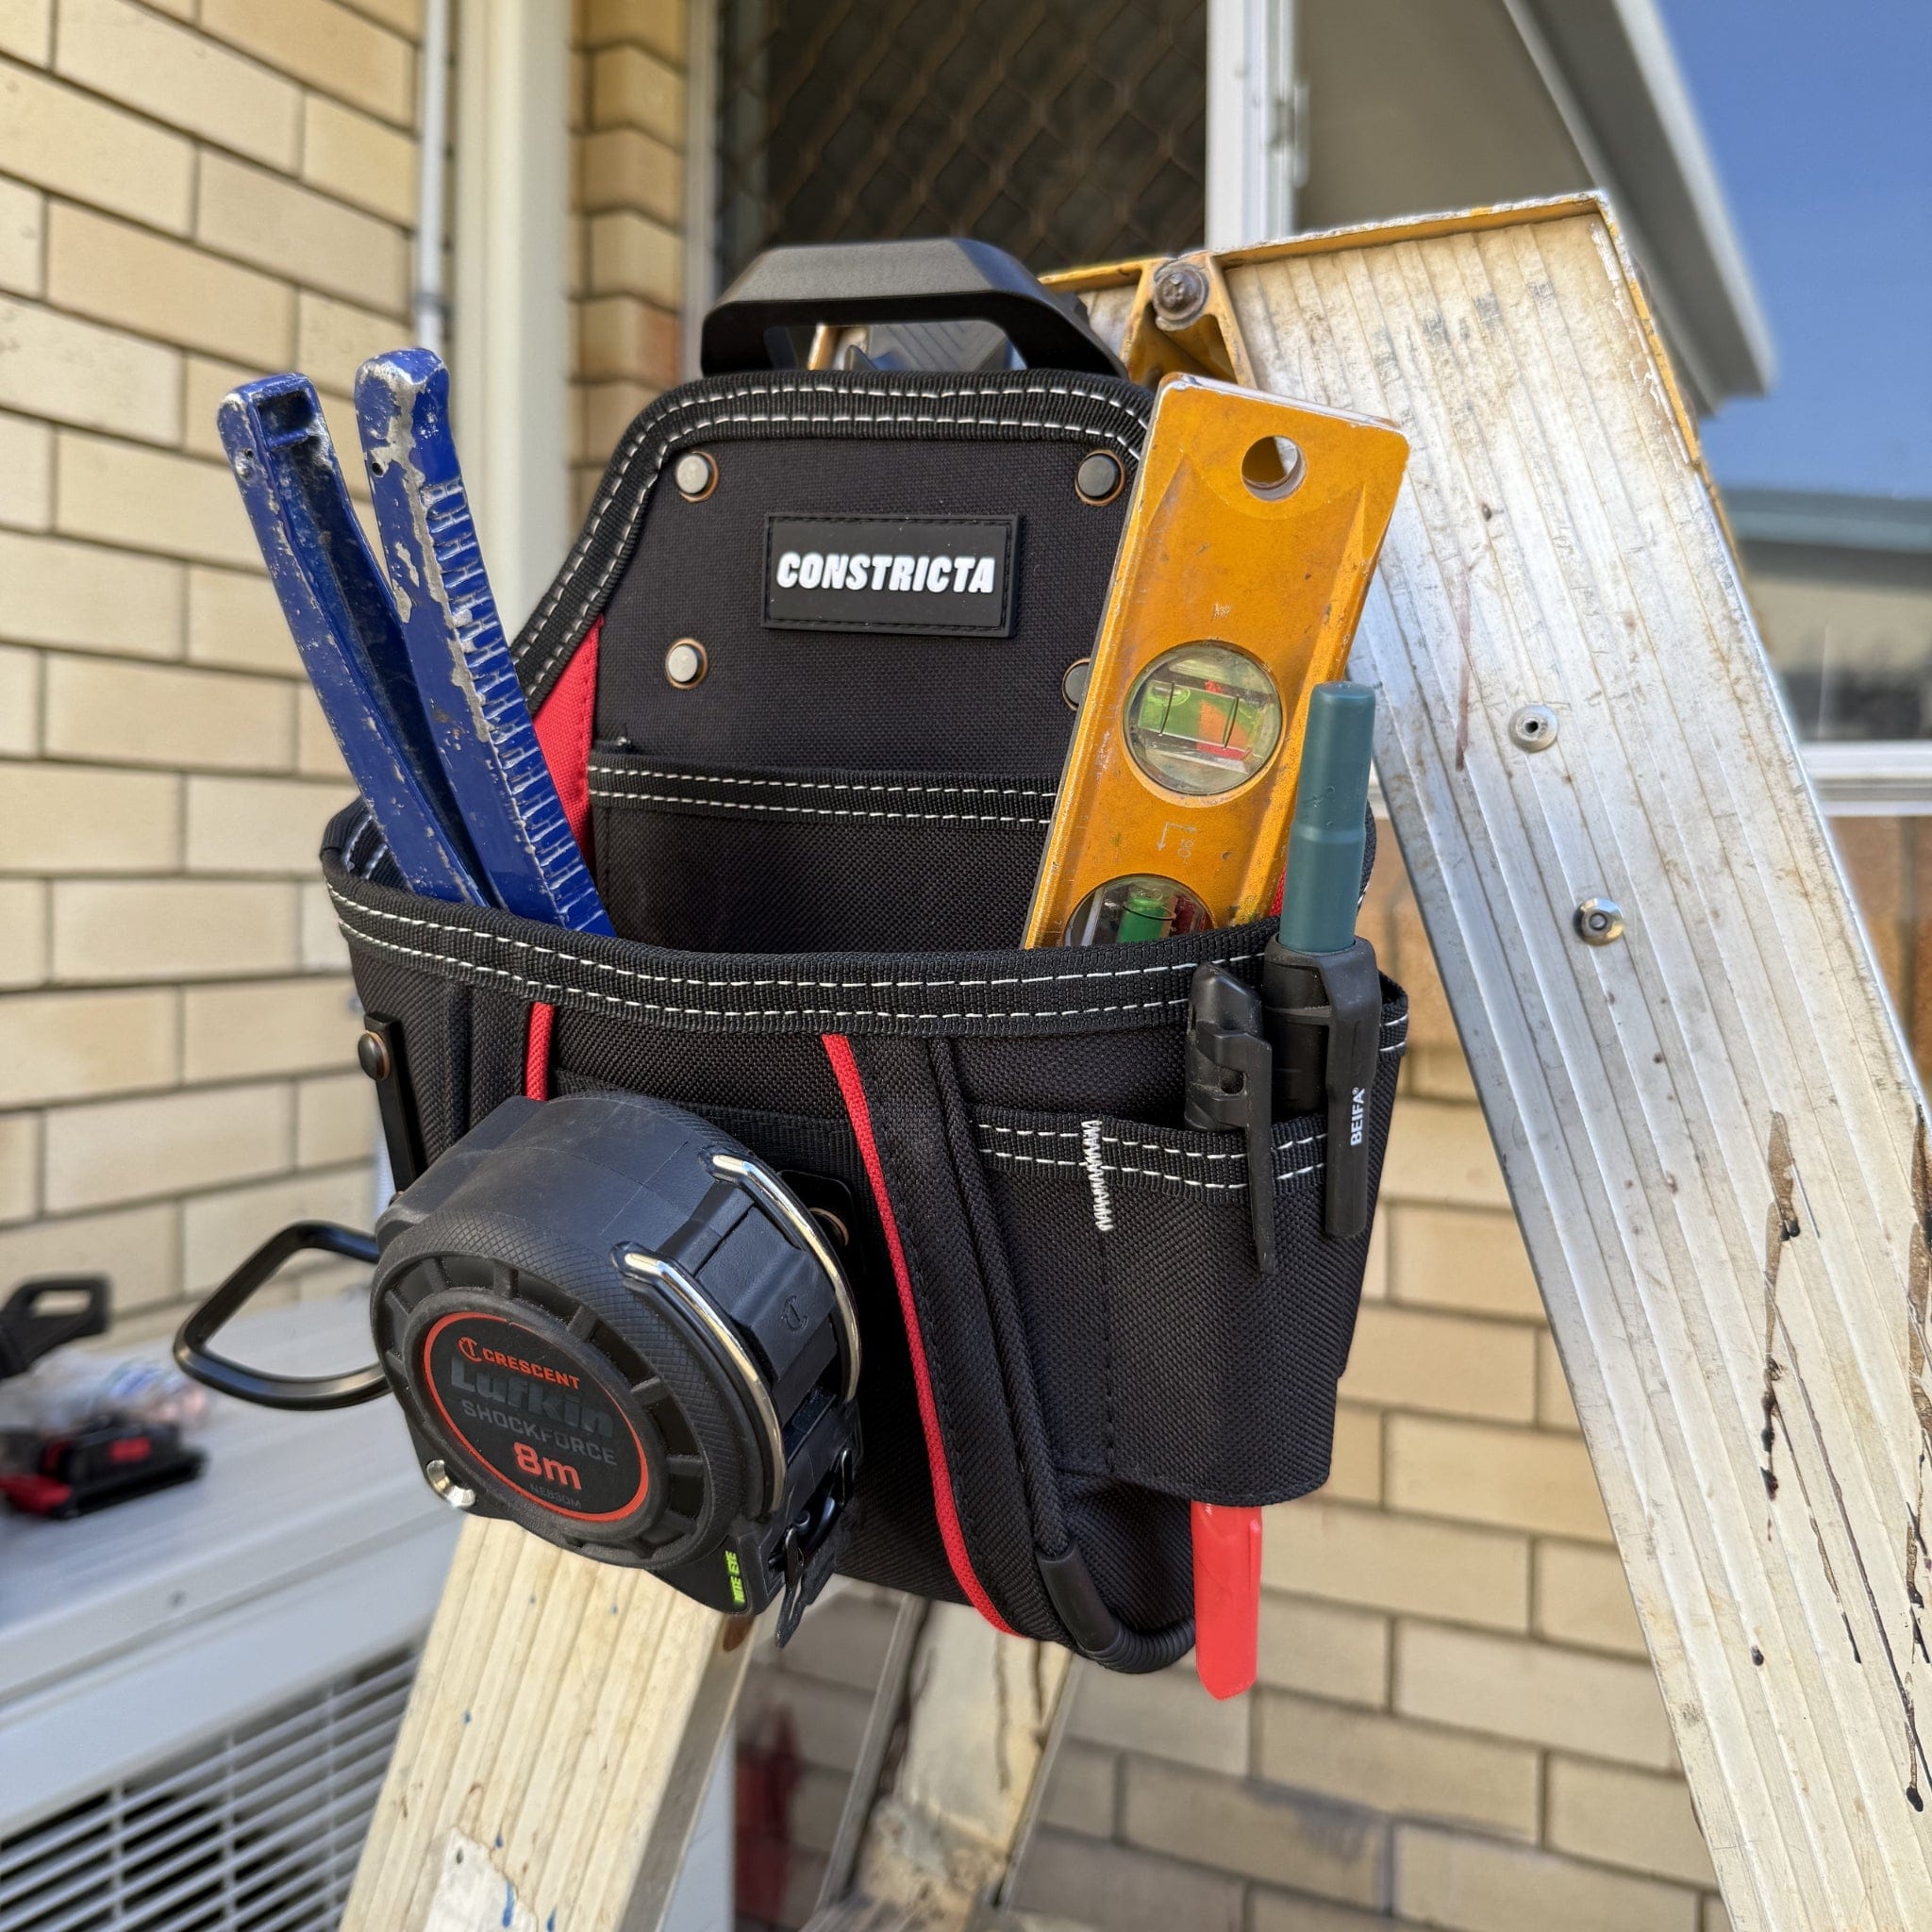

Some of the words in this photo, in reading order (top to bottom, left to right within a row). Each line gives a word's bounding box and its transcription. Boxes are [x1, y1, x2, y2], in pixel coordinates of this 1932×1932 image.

[776, 551, 996, 593] CONSTRICTA
[481, 1347, 581, 1390] CRESCENT
[450, 1357, 614, 1440] Lufkin
[460, 1399, 618, 1466] SHOCKFORCE
[513, 1441, 582, 1491] 8m
[724, 1550, 740, 1574] EYE
[730, 1575, 745, 1604] NITE
